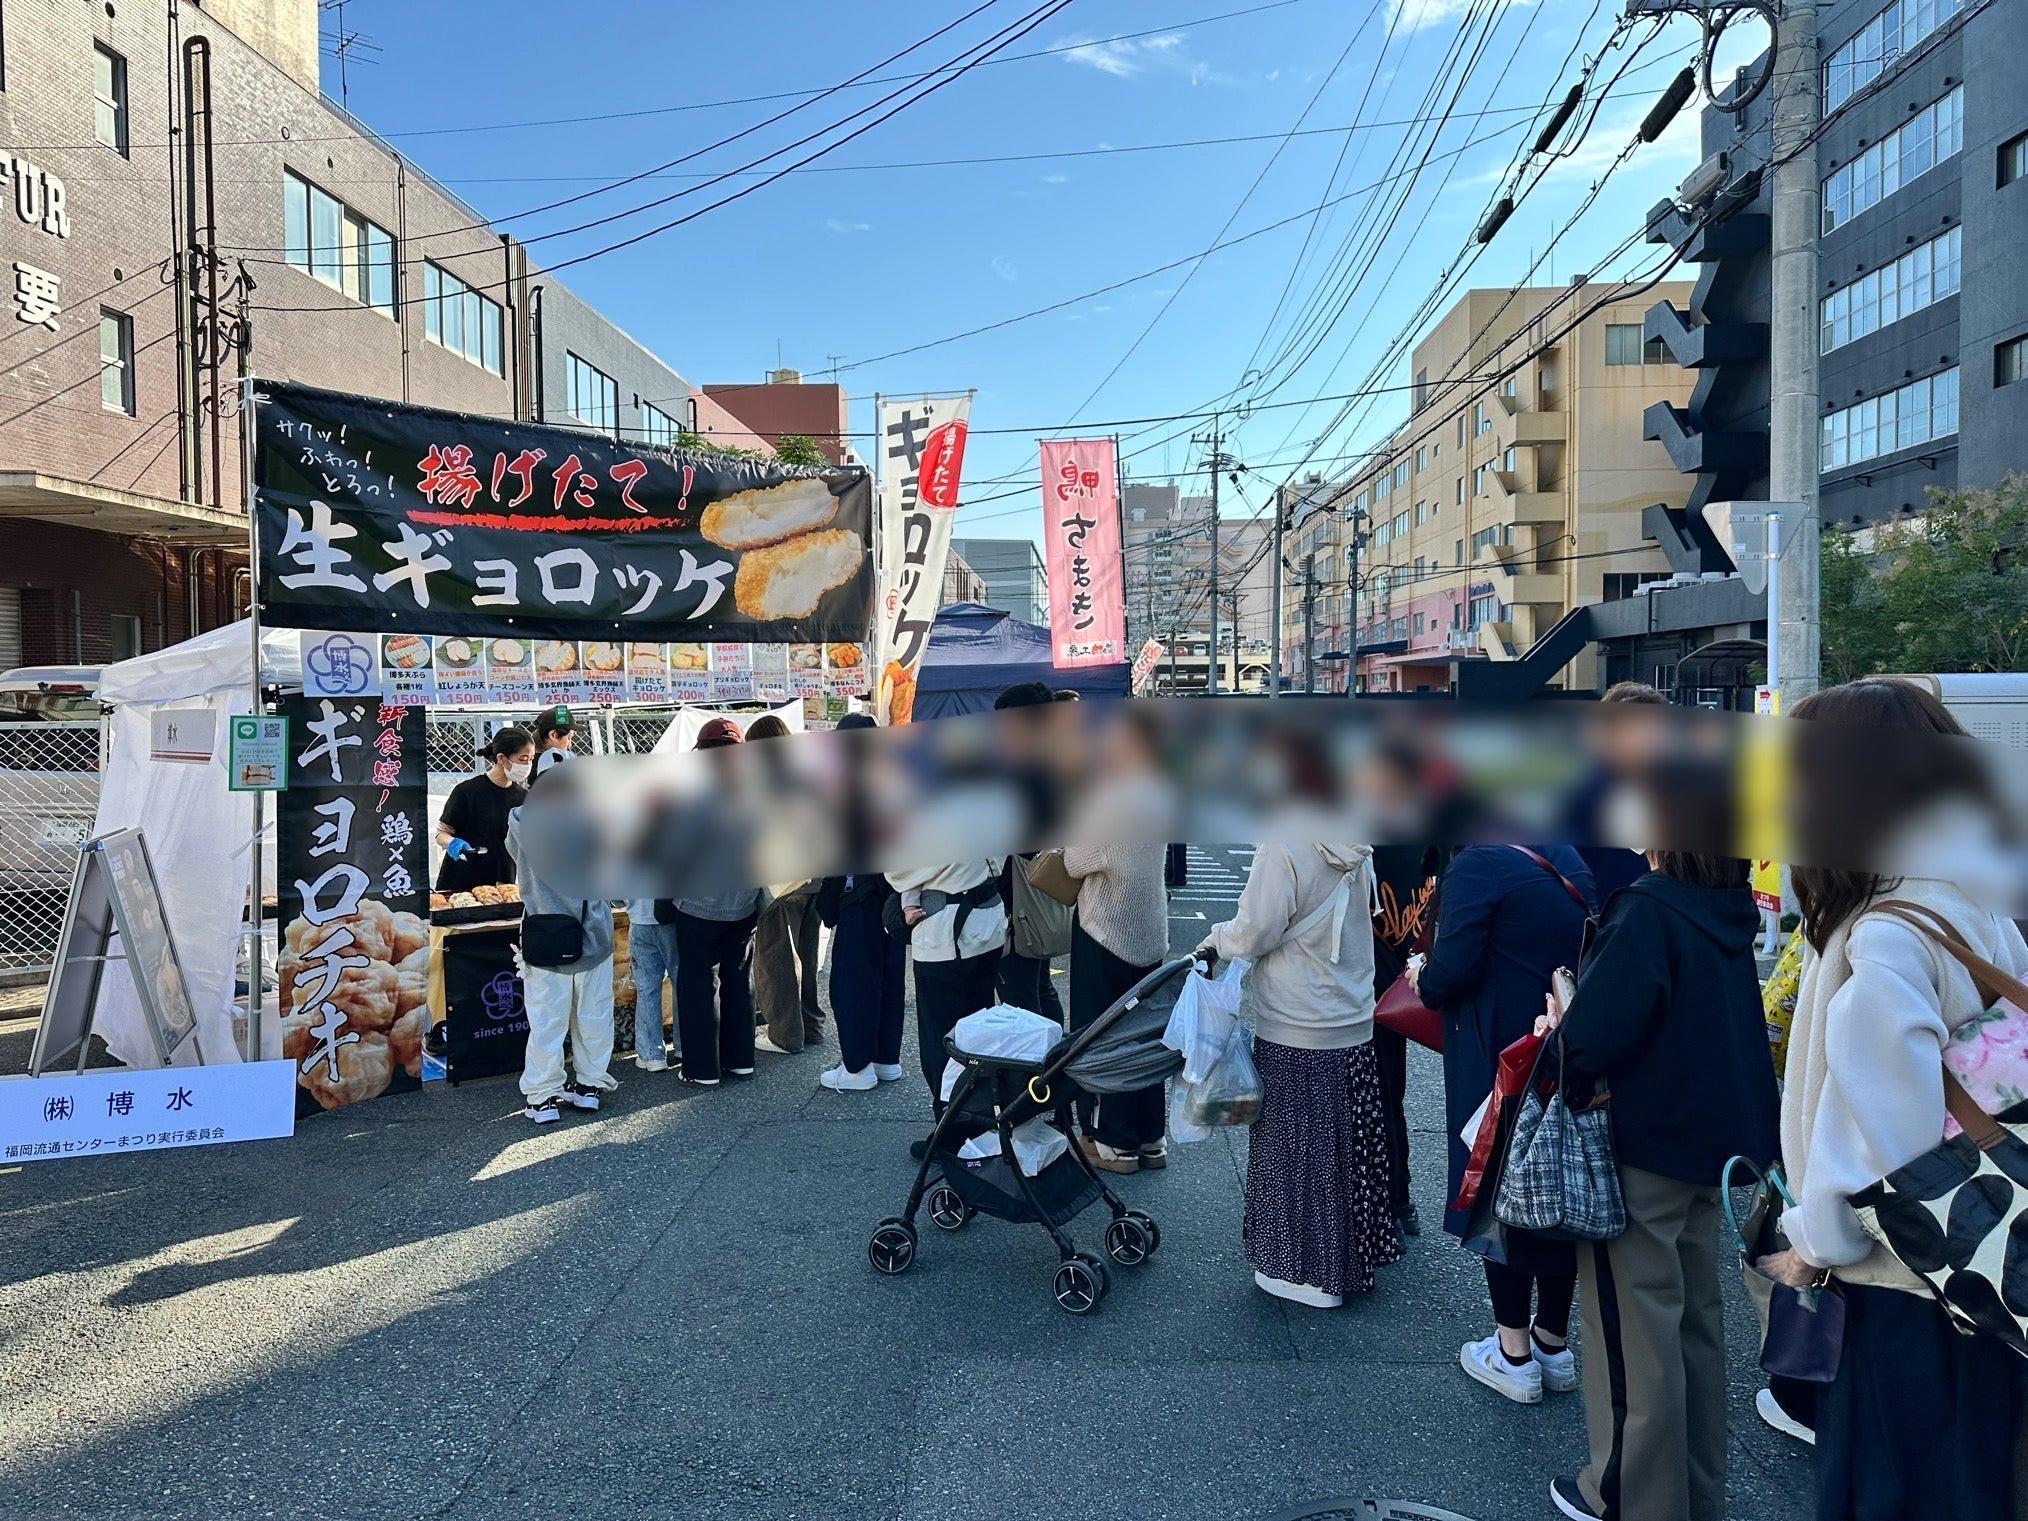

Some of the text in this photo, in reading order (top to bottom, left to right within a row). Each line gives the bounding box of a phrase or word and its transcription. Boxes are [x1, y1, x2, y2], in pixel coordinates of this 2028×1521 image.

[13, 261, 61, 332] 要
[276, 420, 347, 445] サクッ！
[300, 446, 372, 471] ふわっ！
[932, 427, 957, 506] 揚げたて
[416, 443, 694, 514] 揚げたて！
[322, 472, 395, 499] とろっ！
[277, 500, 735, 620] 生ギョロッケ
[331, 649, 350, 674] 博水
[438, 681, 486, 690] 紅しょうが天
[488, 683, 535, 691] チーズコーン天
[632, 684, 666, 692] ギョロッケ
[835, 686, 862, 697] 350円
[447, 693, 483, 704] 150円
[495, 692, 530, 702] 150円
[588, 692, 621, 703] 250円
[634, 692, 664, 702] 300円
[676, 690, 705, 700] 200円
[796, 688, 820, 697] 350円
[391, 693, 430, 705] 150円
[545, 694, 580, 705] 250円
[294, 698, 371, 1083] ギョロチキ
[473, 1020, 531, 1039] since 190
[4, 1126, 226, 1158] 福岡流通センターまつり実行委員会
